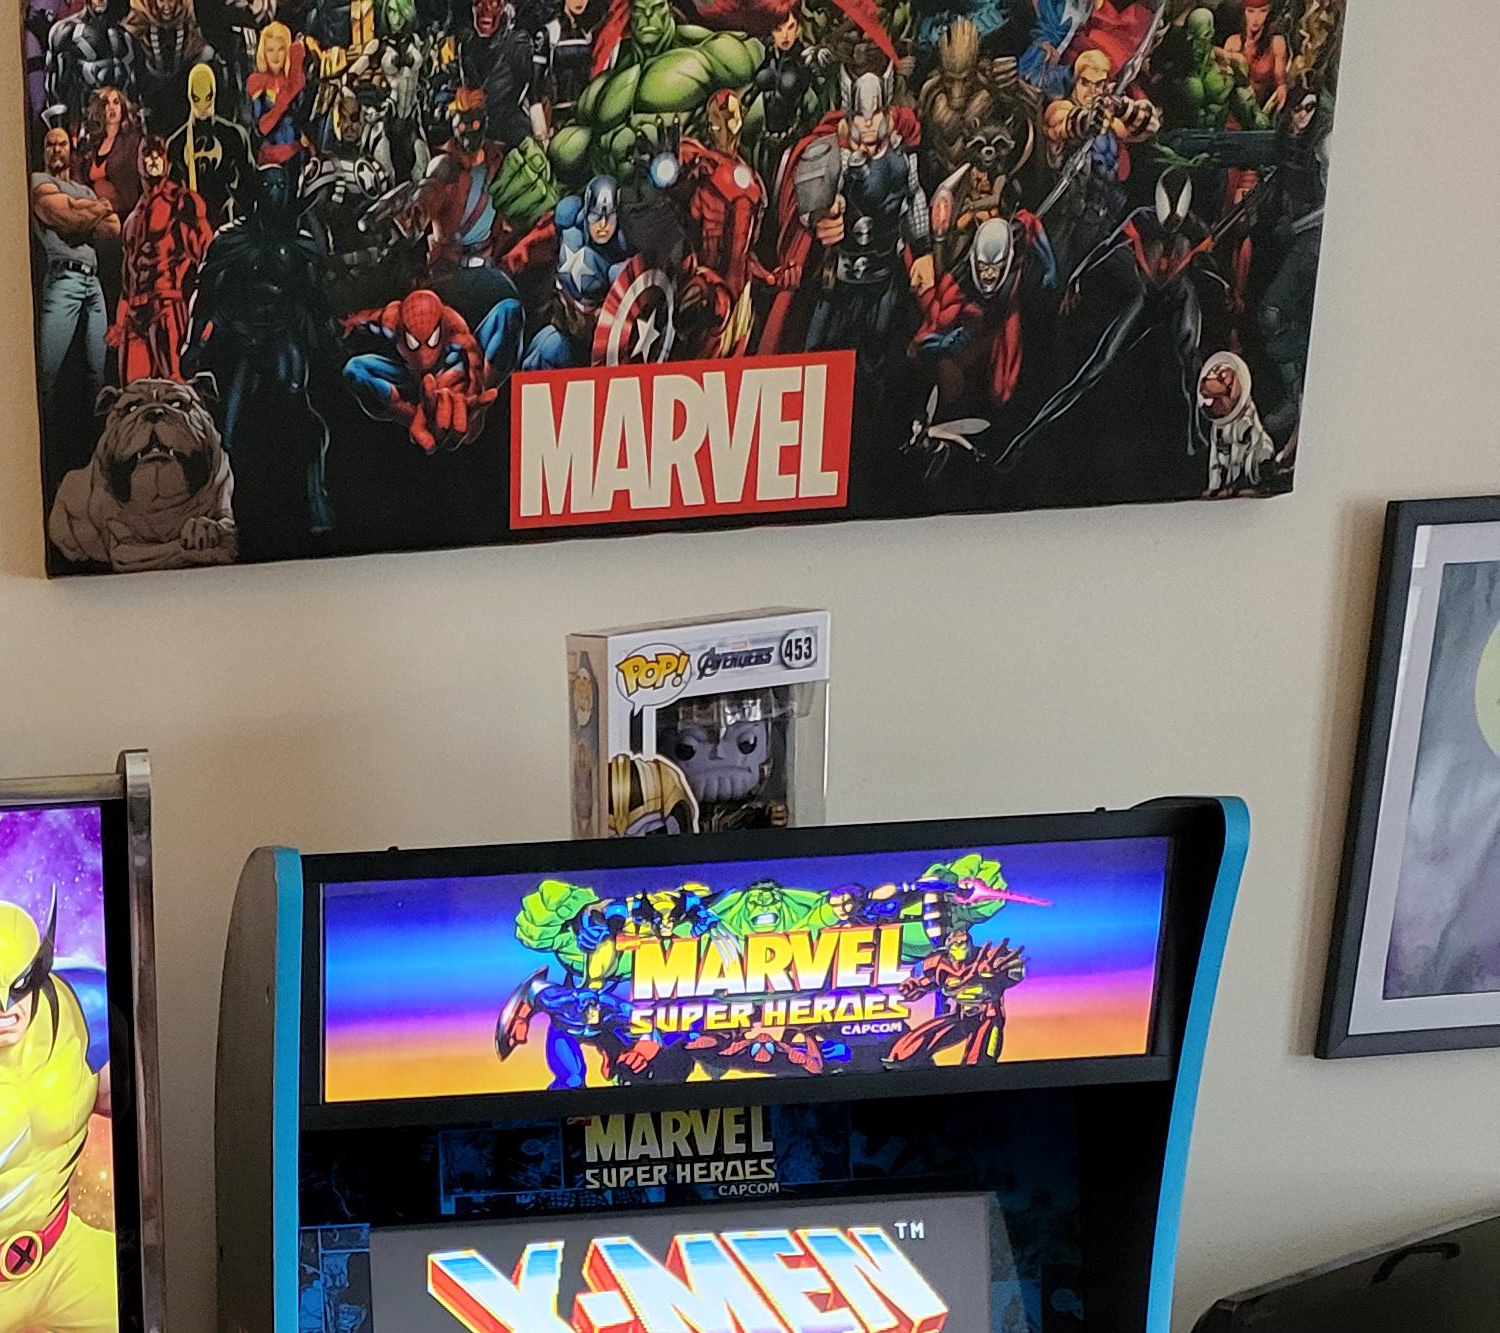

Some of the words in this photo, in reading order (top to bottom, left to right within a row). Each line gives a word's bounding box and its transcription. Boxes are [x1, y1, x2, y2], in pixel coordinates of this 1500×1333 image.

[520, 364, 838, 517] MARVEL
[785, 636, 813, 662] 453
[615, 652, 692, 697] POP!
[633, 926, 911, 1000] MARVEL
[631, 1002, 753, 1035] SUPER
[763, 996, 911, 1027] HEROES
[840, 1022, 903, 1036] CAPCOM
[585, 1106, 774, 1163] MARVEL
[586, 1164, 668, 1190] SUPER
[676, 1158, 776, 1184] HEROES
[718, 1182, 780, 1197] CAPCOM
[895, 1221, 926, 1241] TM
